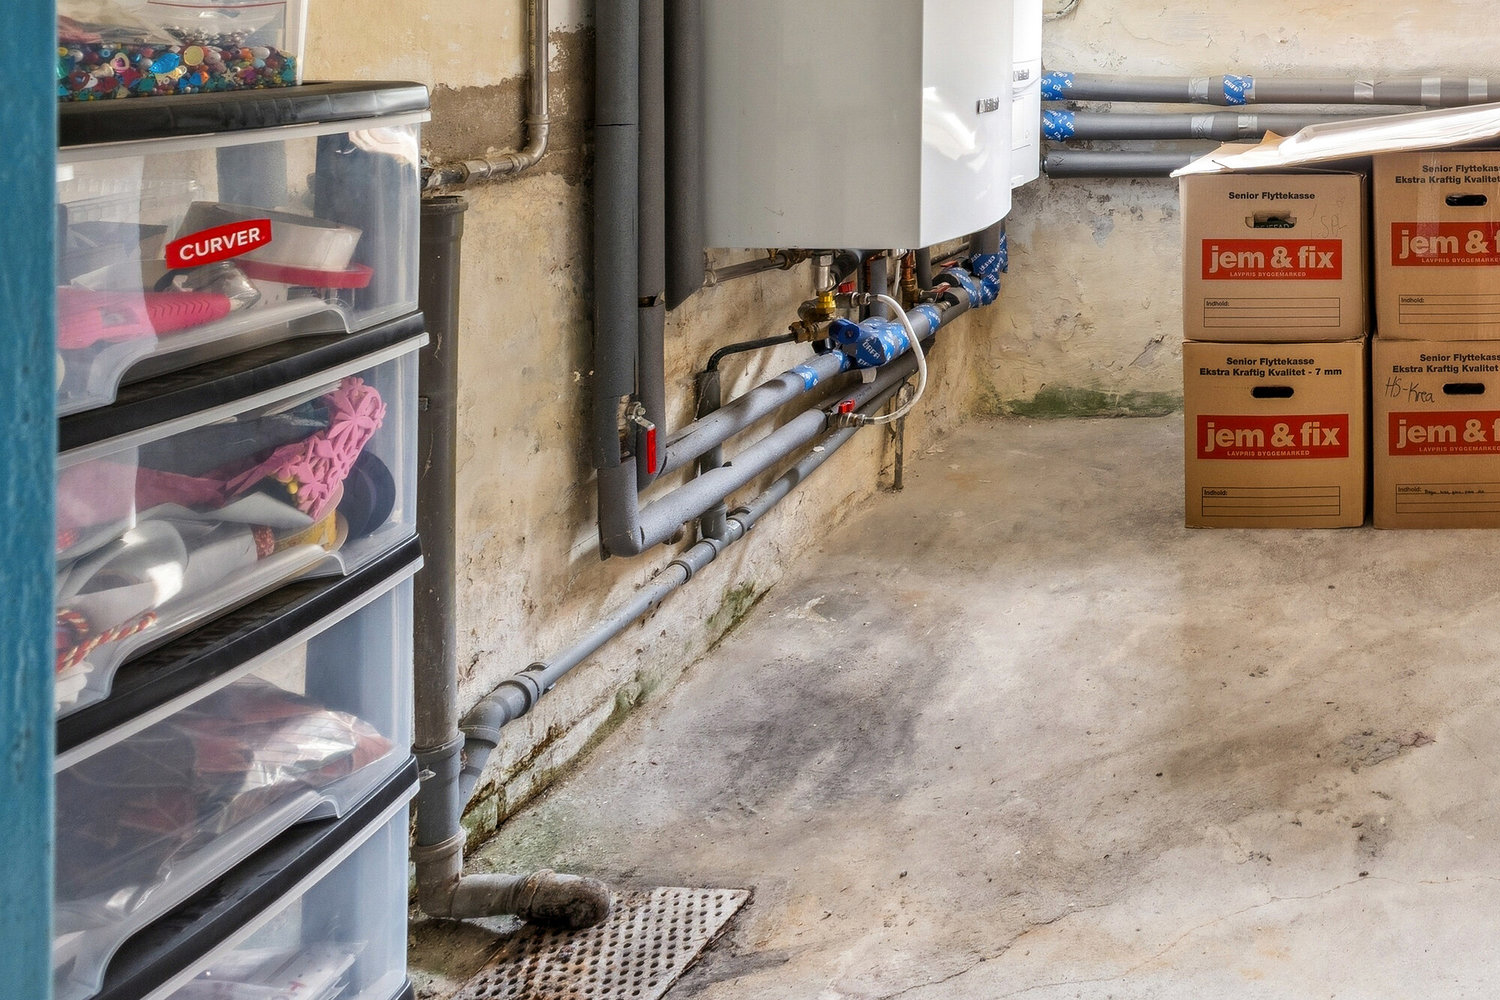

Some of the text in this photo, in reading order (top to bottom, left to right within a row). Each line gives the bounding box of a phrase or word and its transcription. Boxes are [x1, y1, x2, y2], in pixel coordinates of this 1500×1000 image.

[1422, 164, 1453, 172] Senior
[1395, 176, 1426, 184] Ekstra
[1428, 176, 1461, 185] Kraftig
[1228, 192, 1316, 200] Senior Flyttekasse
[180, 227, 260, 260] CURVER
[1399, 229, 1459, 260] jem
[1465, 230, 1490, 254] &
[1208, 245, 1334, 274] jem & fix
[1226, 357, 1315, 367] Senior Flyttekasse
[1420, 354, 1450, 362] Senior
[1200, 368, 1230, 376] Ekstra
[1232, 368, 1266, 378] Kraftig
[1268, 368, 1306, 376] Kvalitet
[1315, 368, 1322, 376] 7
[1392, 365, 1423, 373] Ekstra
[1426, 365, 1459, 374] Kraftig
[1462, 364, 1499, 372] Kvalitet
[1204, 422, 1341, 452] jem & fix
[1396, 419, 1457, 449] jem
[1462, 418, 1488, 443] &
